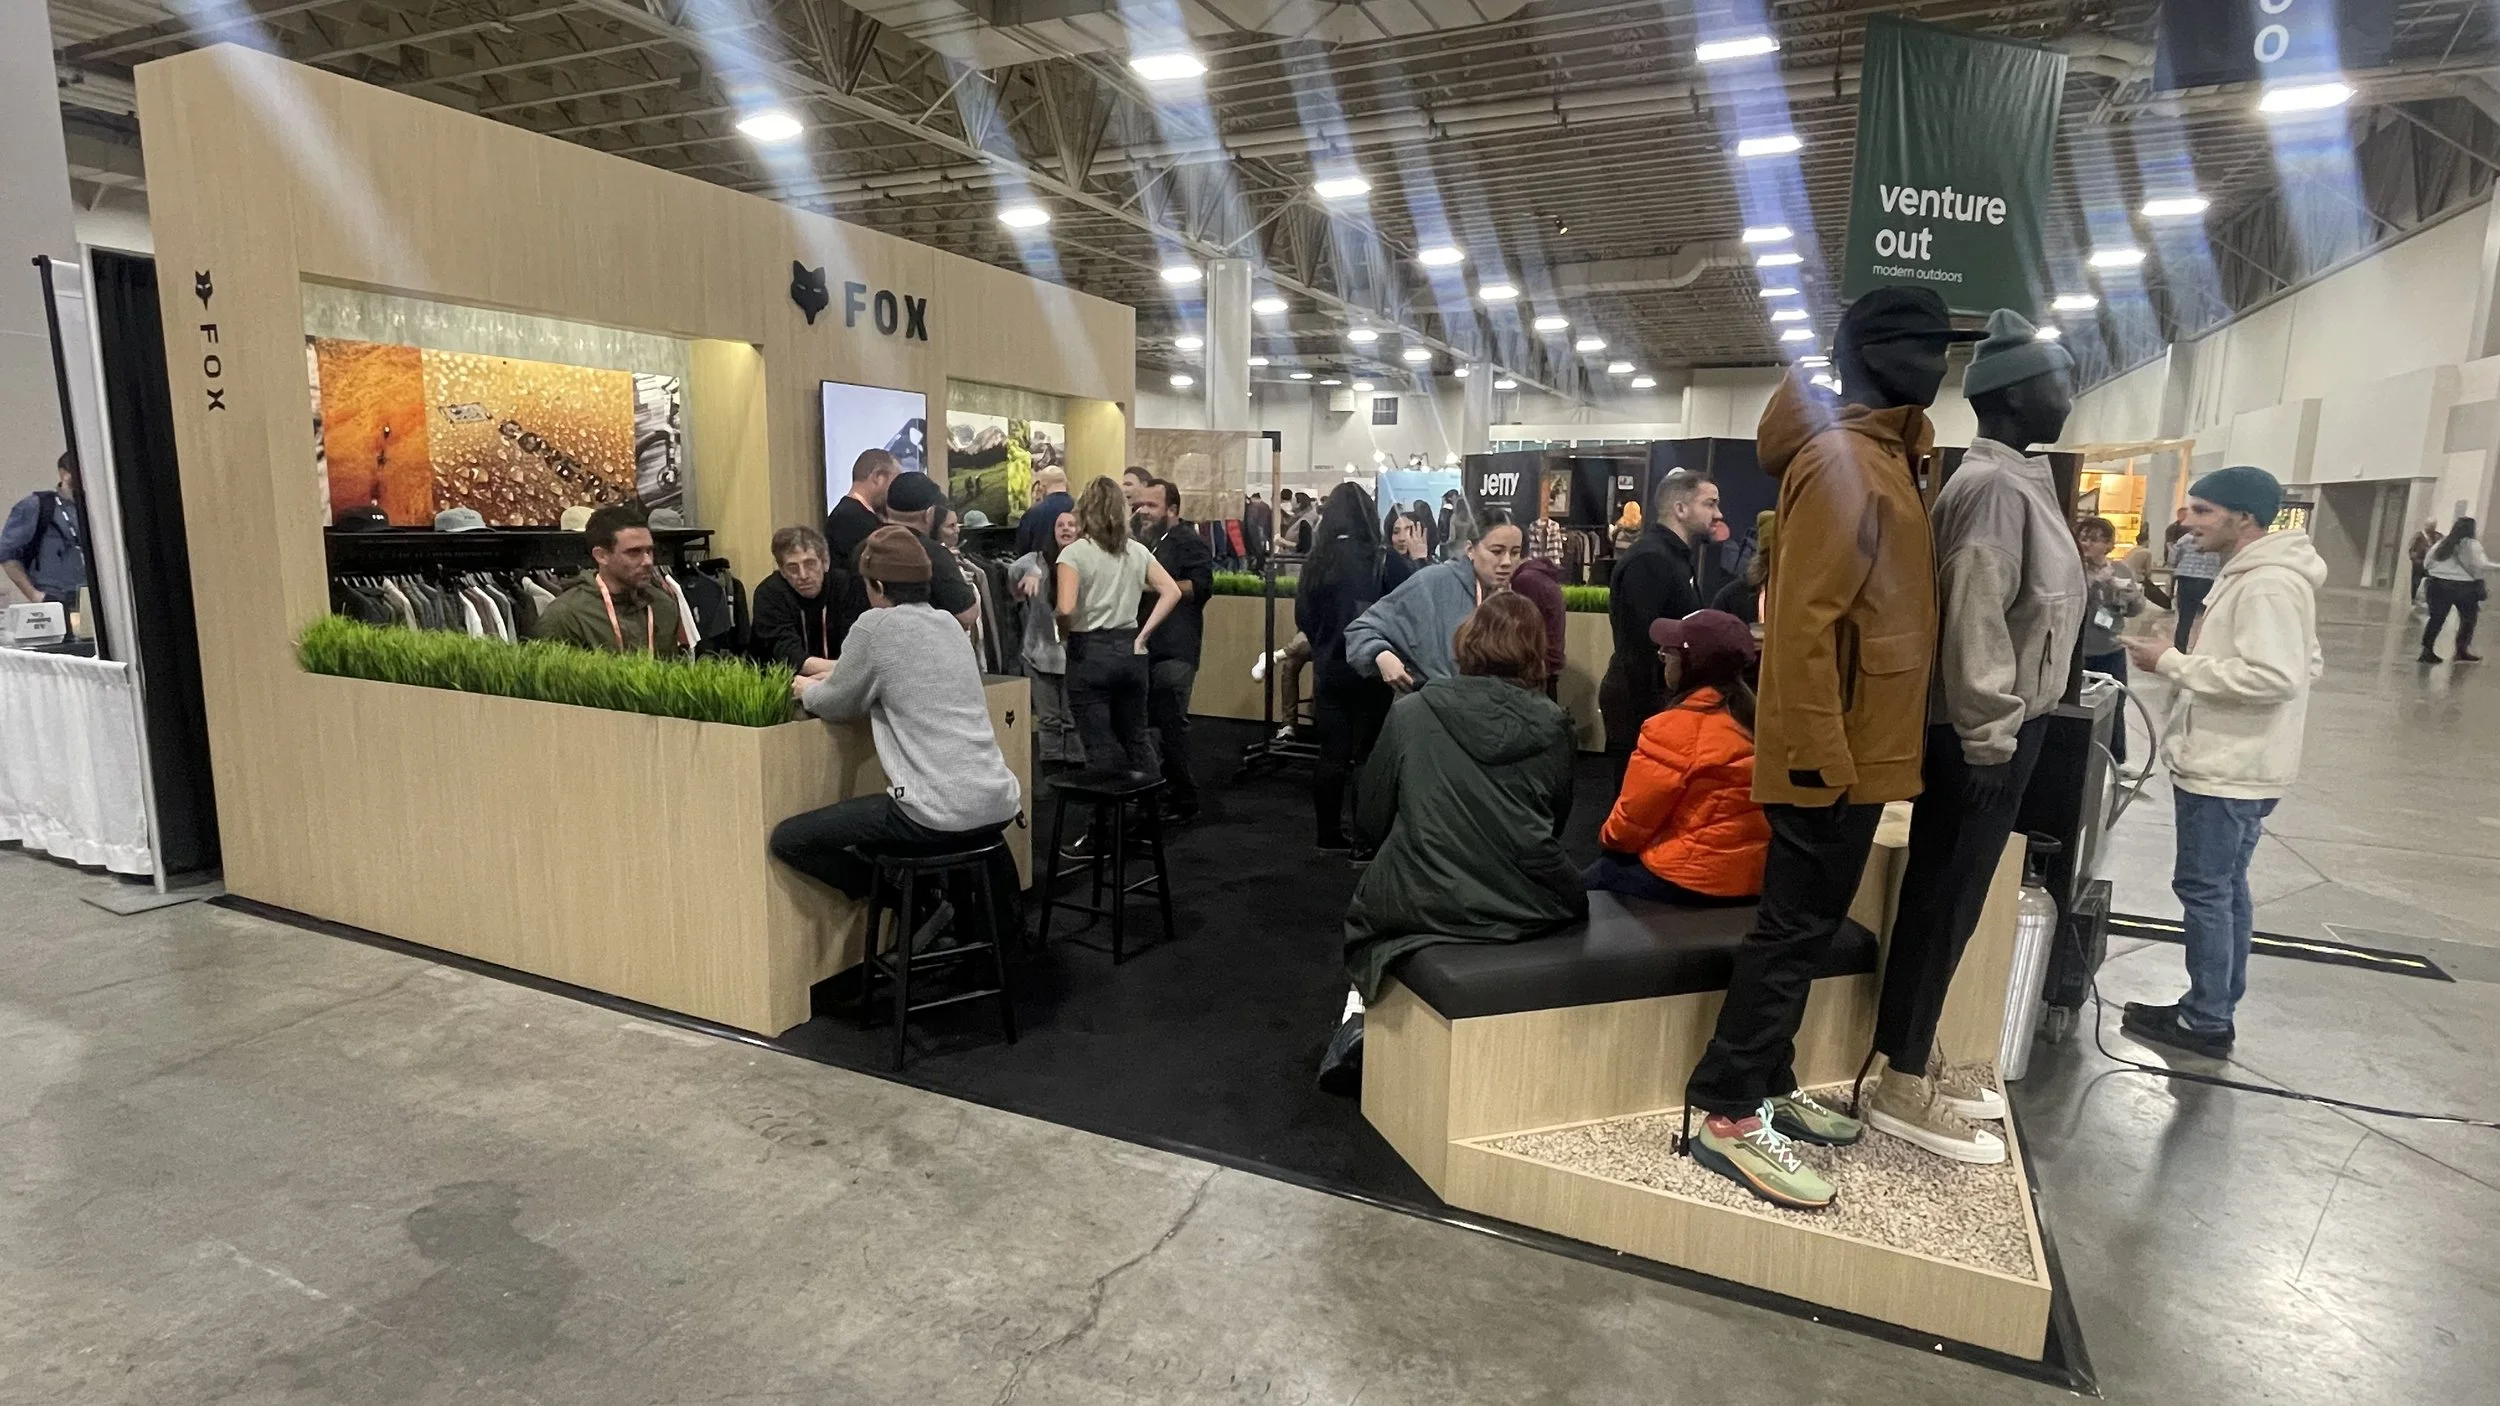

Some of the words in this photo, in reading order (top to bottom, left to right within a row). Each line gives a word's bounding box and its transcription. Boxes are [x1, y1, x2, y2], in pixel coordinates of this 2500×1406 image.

[1880, 184, 2007, 225] venture
[1875, 227, 1933, 261] out
[1872, 264, 1915, 278] modern
[1916, 269, 1963, 283] outdoors
[844, 280, 928, 341] FOX
[199, 323, 226, 412] FOX
